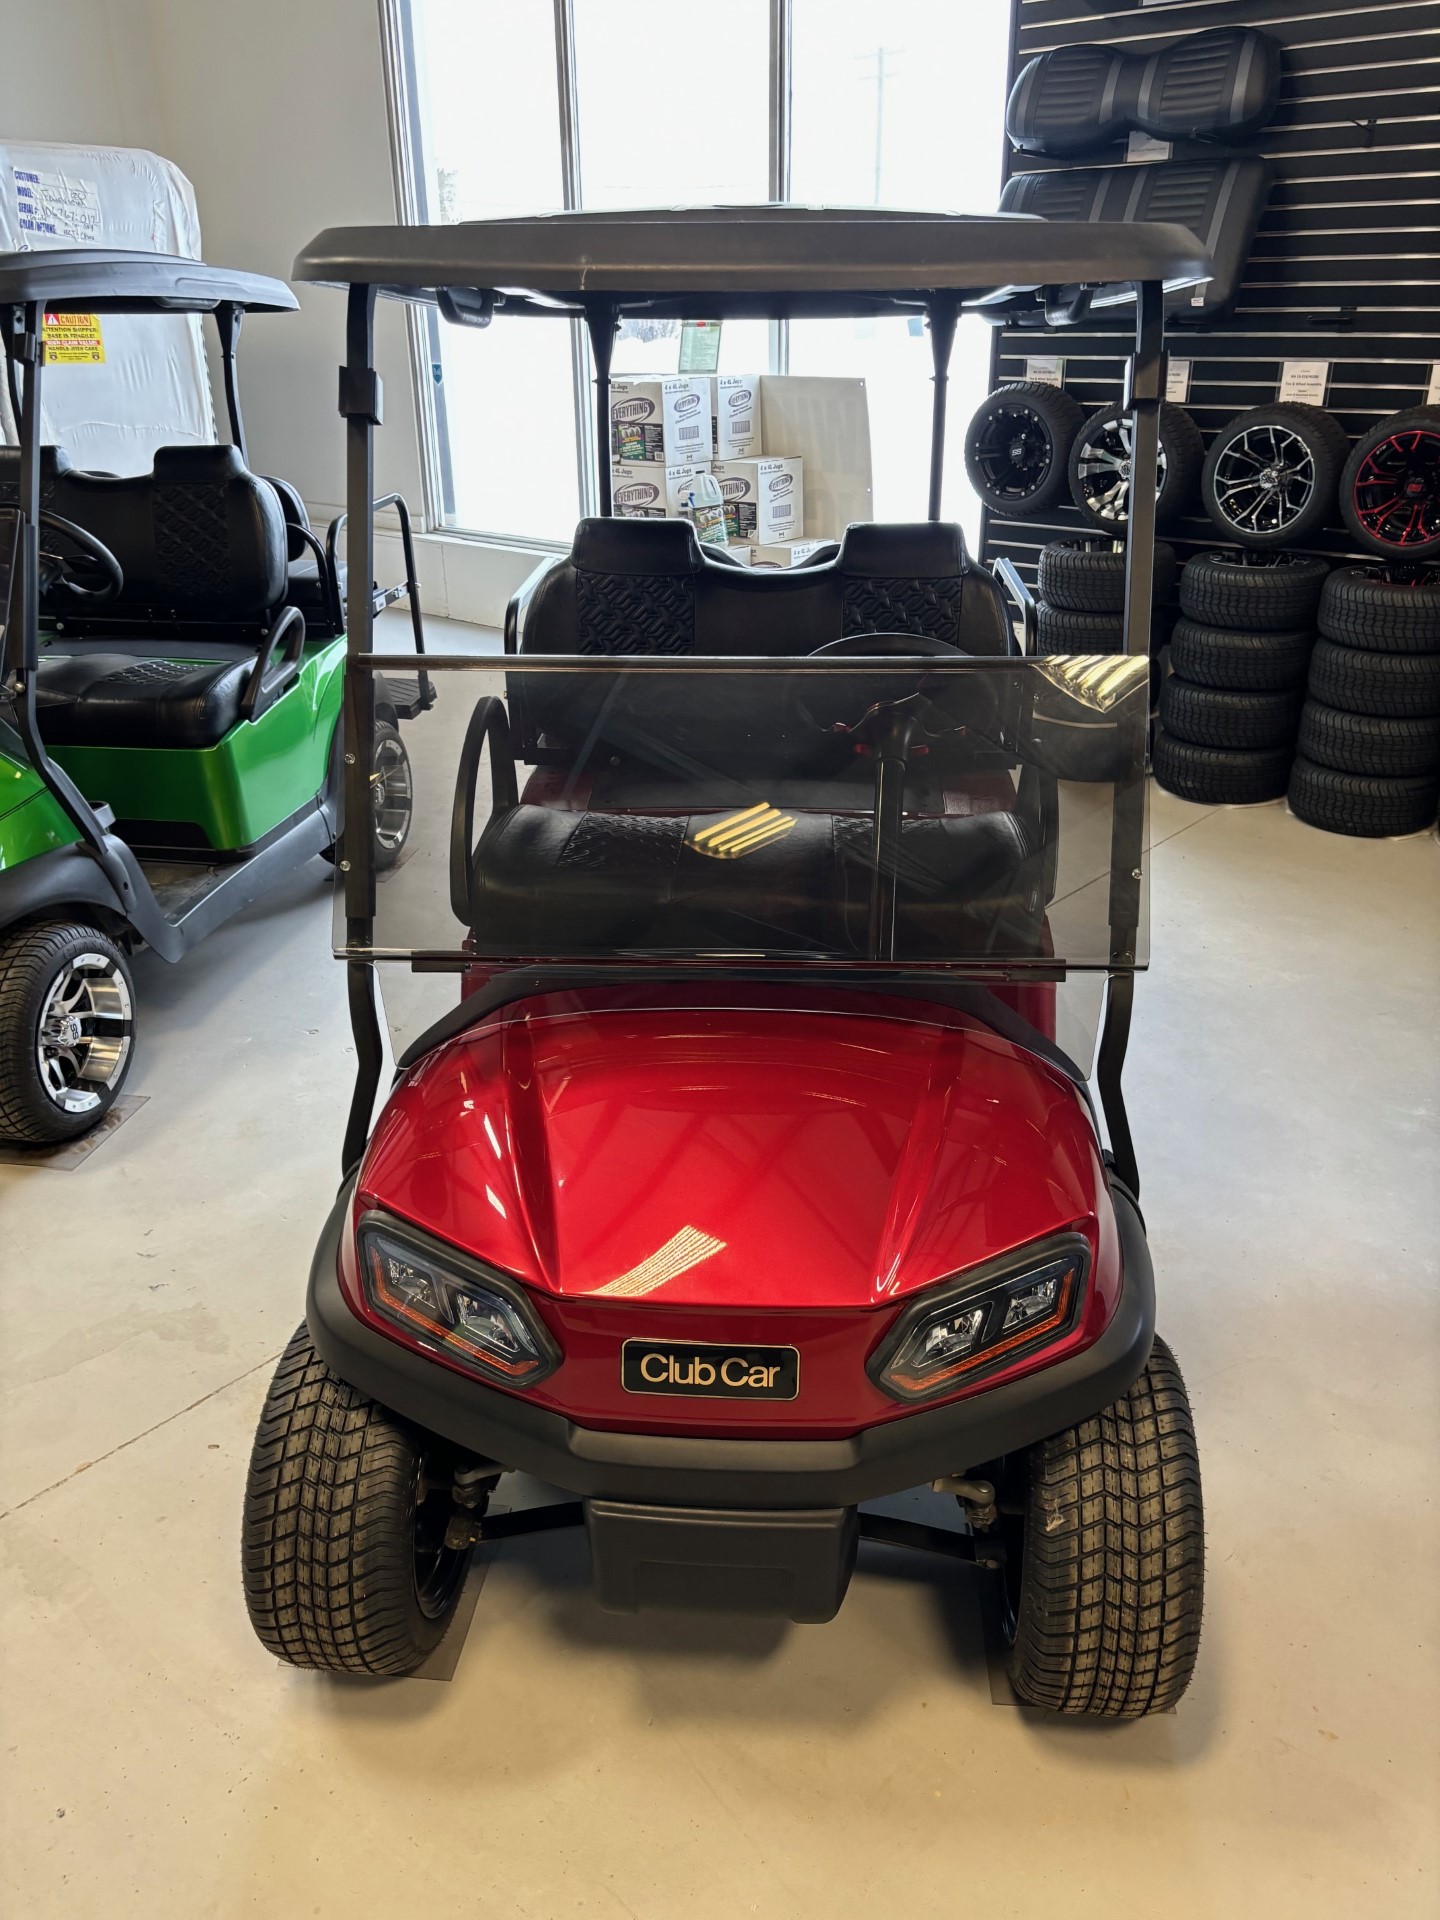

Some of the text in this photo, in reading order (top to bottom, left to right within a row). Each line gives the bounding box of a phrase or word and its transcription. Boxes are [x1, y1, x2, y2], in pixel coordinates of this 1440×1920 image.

[60, 315, 89, 324] CAUTION
[613, 401, 648, 420] EVERYTHING
[616, 486, 654, 504] EVERYTHING
[640, 1353, 781, 1388] Club Car
